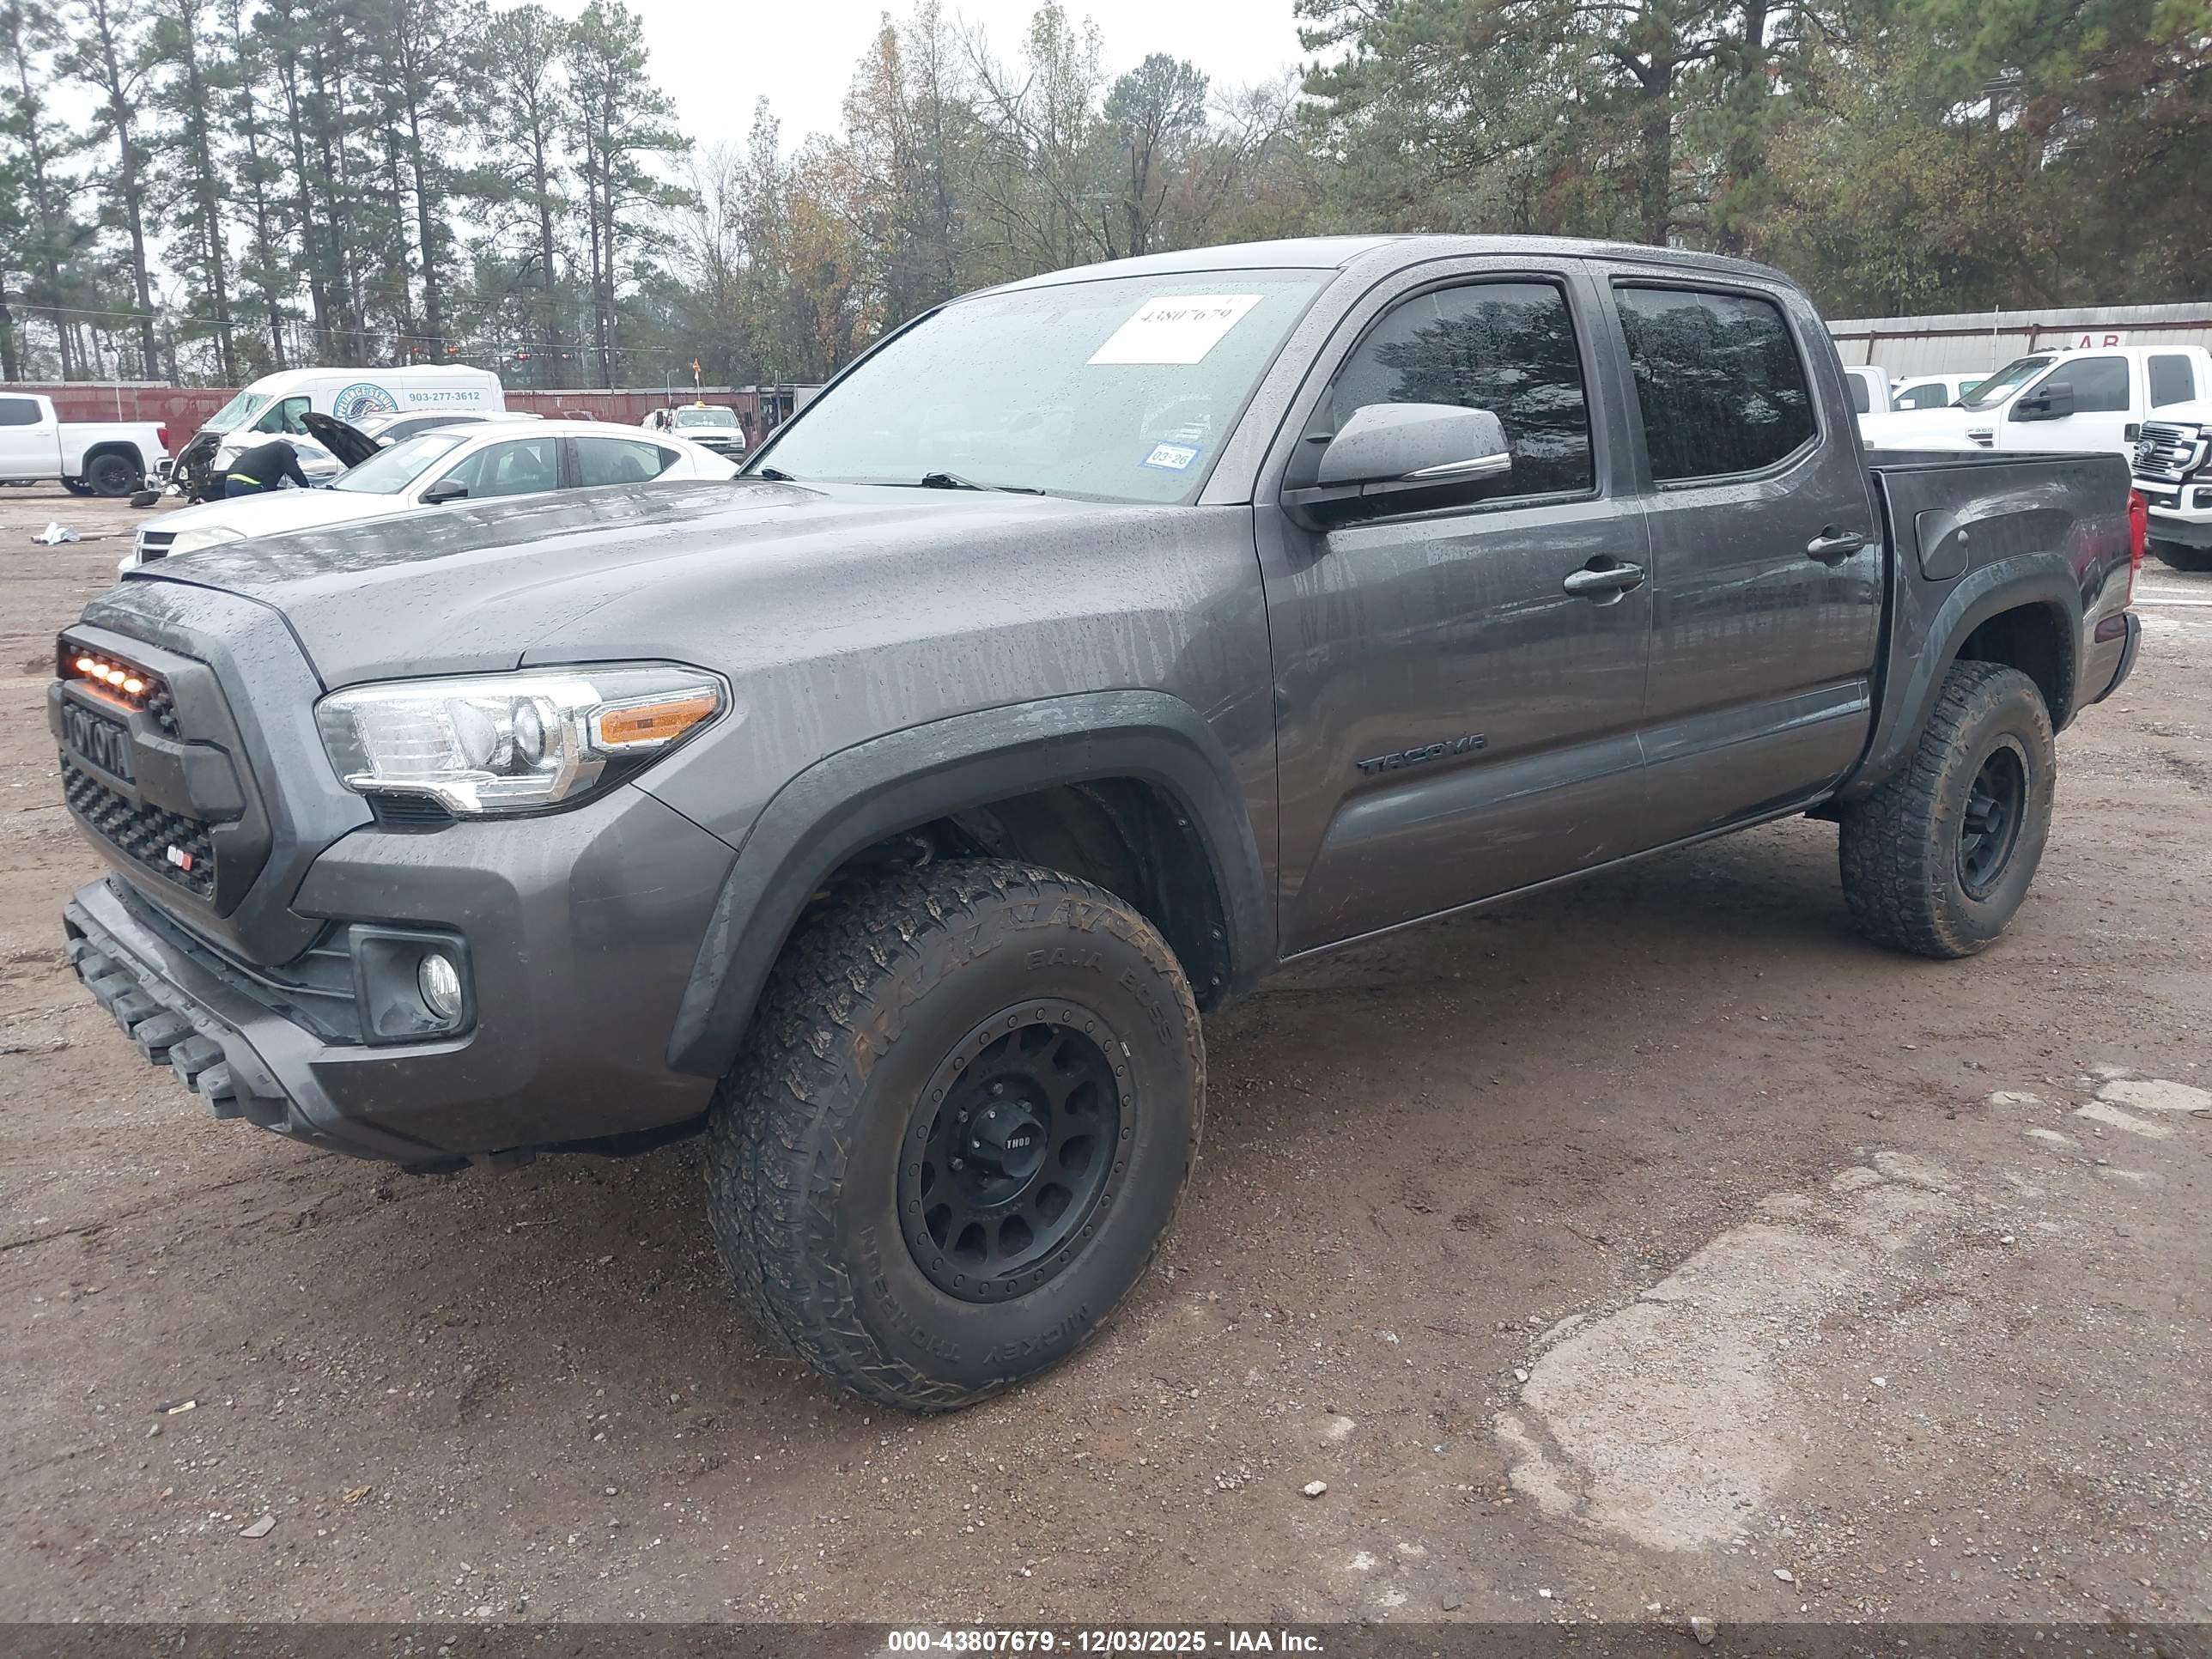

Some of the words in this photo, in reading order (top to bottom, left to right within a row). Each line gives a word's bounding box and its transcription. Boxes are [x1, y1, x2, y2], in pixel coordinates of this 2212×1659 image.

[2079, 335, 2092, 349] A
[337, 386, 367, 417] PPLIANCE
[409, 391, 481, 402] 903-277-3612
[63, 703, 132, 779] TOYOTA
[1356, 733, 1487, 776] TACOMA
